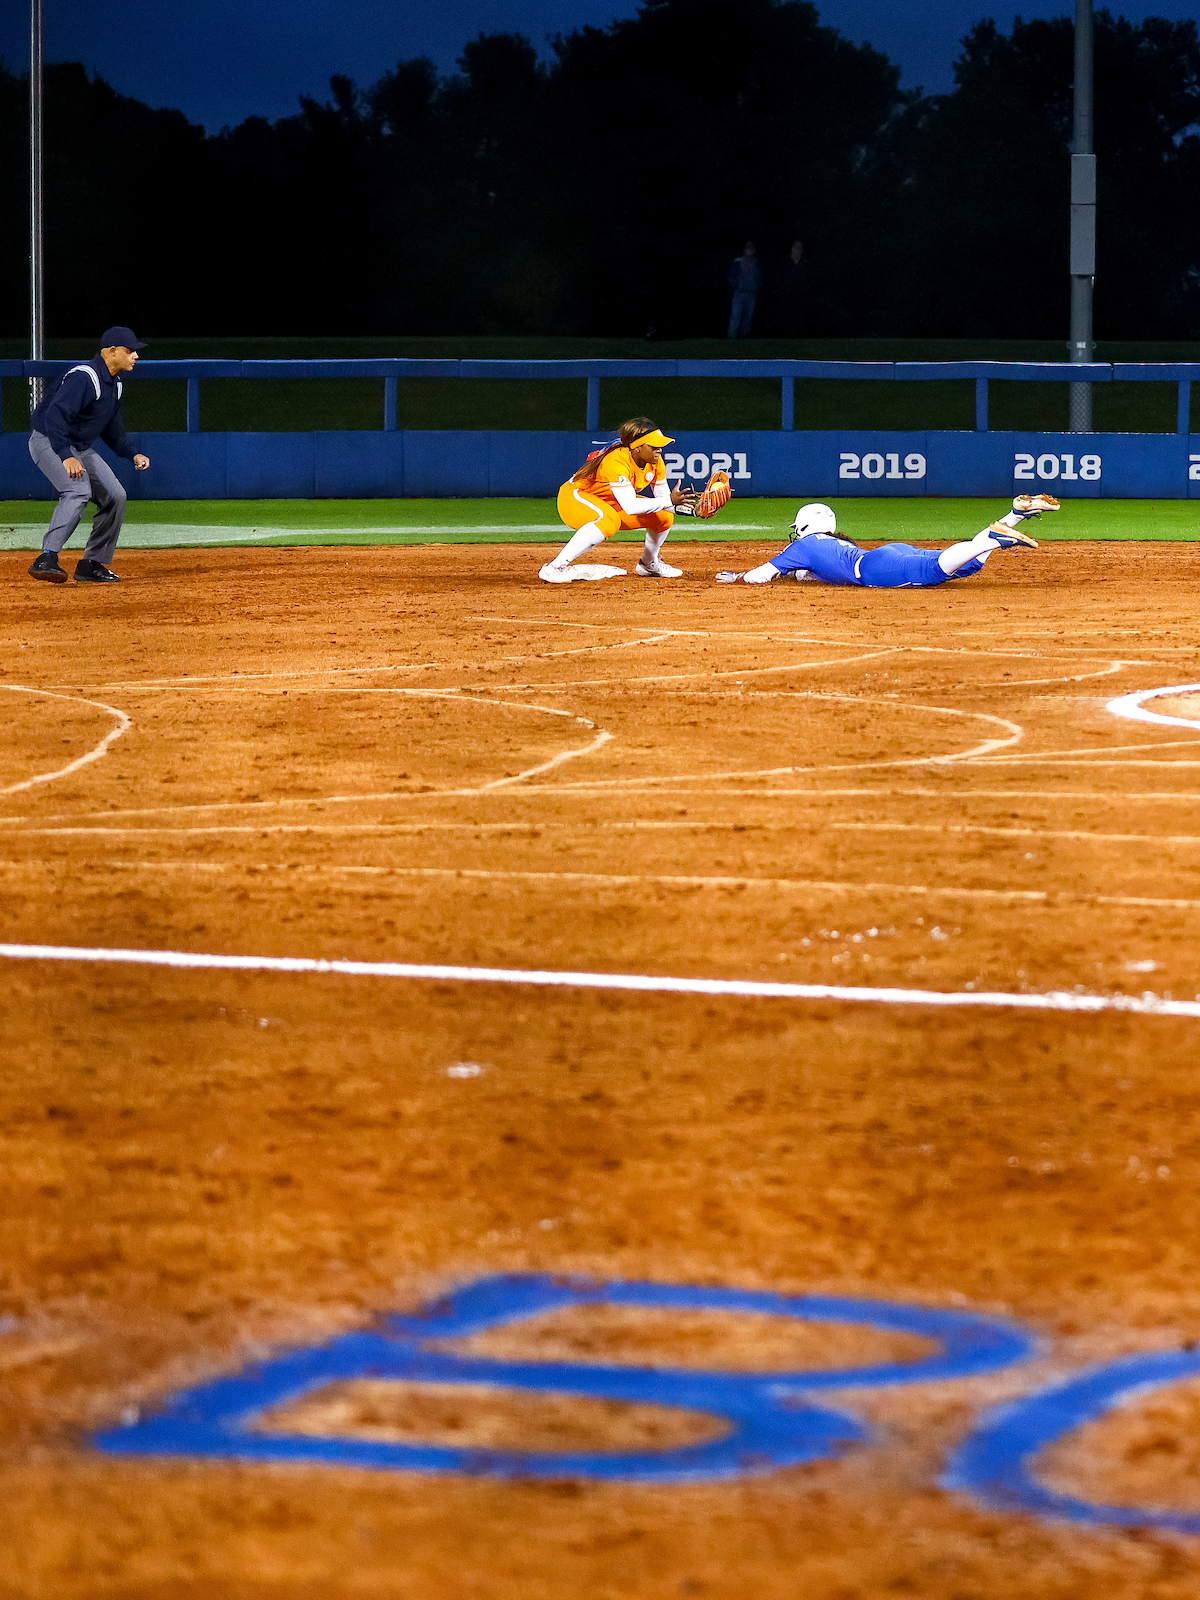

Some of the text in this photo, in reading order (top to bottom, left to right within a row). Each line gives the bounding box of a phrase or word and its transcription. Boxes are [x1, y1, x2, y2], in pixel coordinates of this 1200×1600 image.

[664, 452, 752, 480] 2021
[839, 452, 927, 479] 2019
[1013, 453, 1102, 480] 2018
